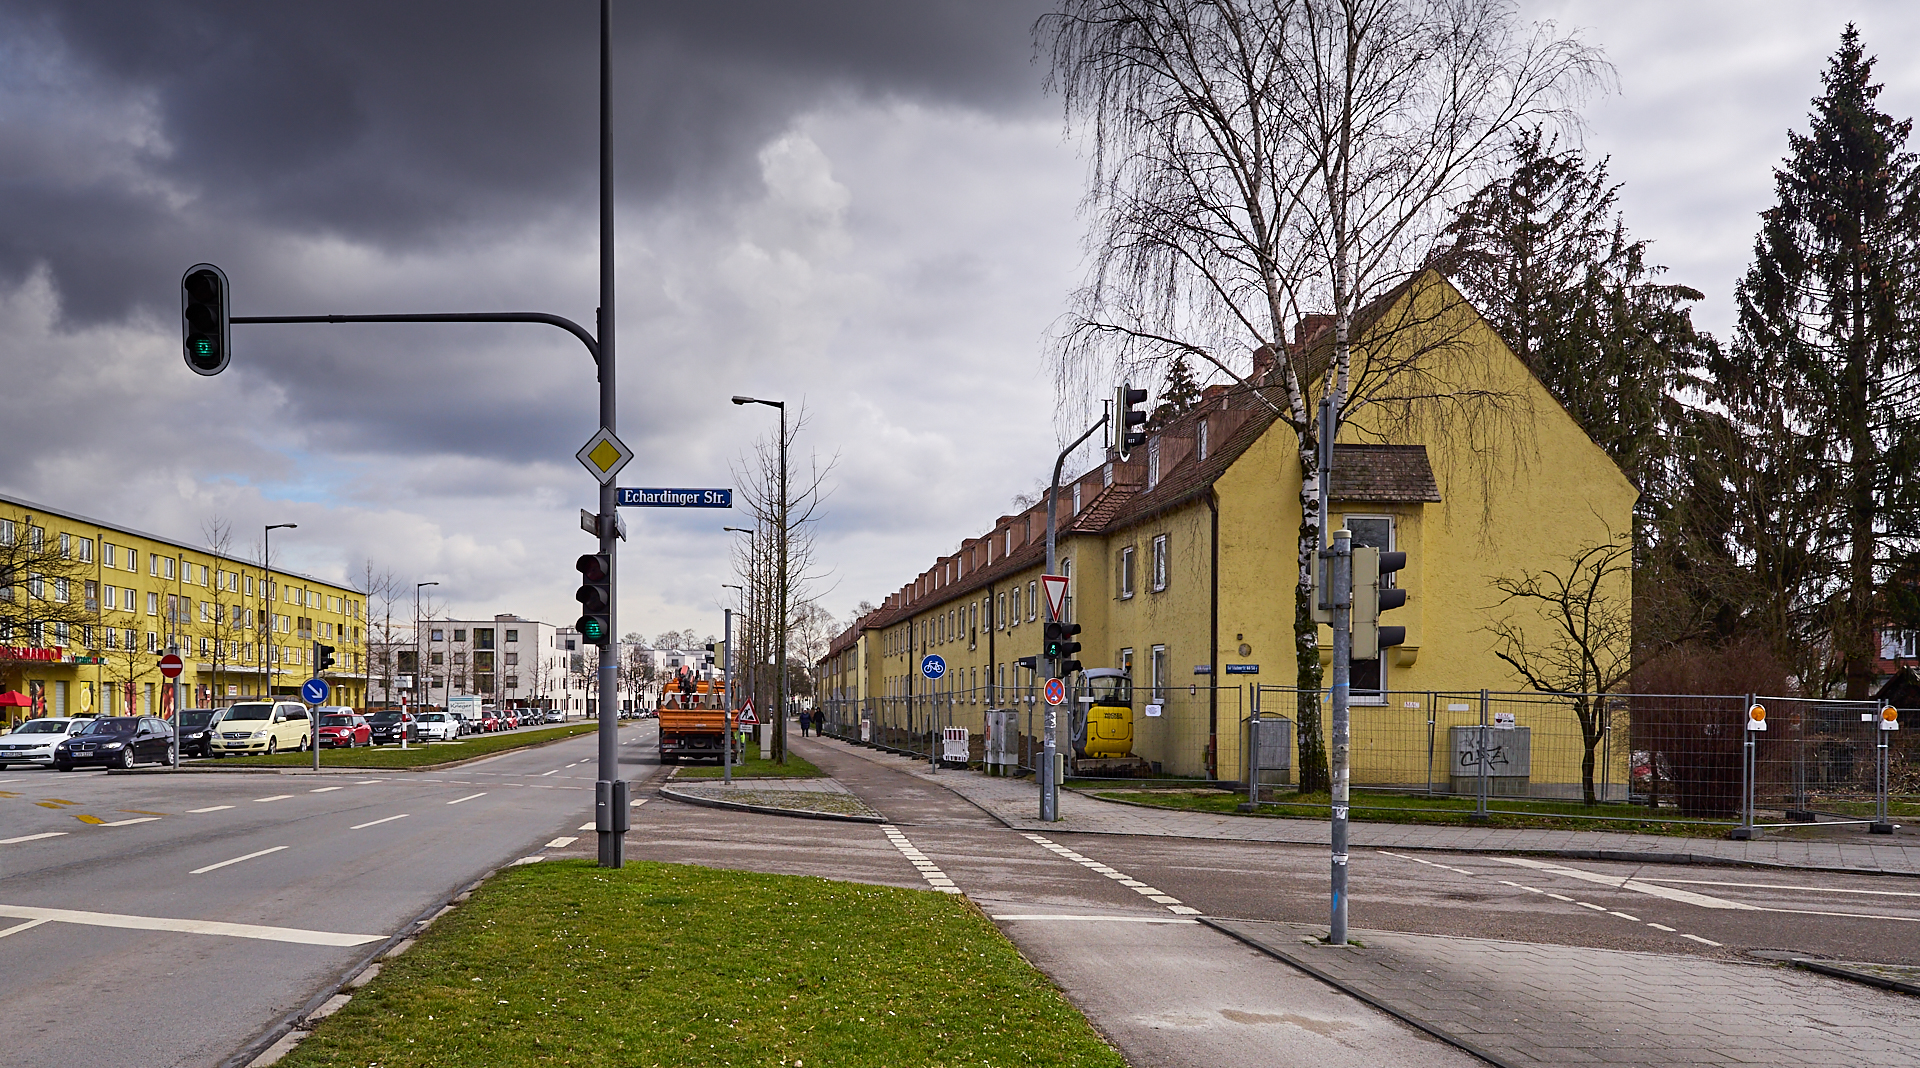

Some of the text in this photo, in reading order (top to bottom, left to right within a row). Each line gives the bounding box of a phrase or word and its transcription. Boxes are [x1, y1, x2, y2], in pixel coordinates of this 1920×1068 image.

[624, 489, 726, 506] Echardinger Str.
[450, 702, 472, 710] Krieger
